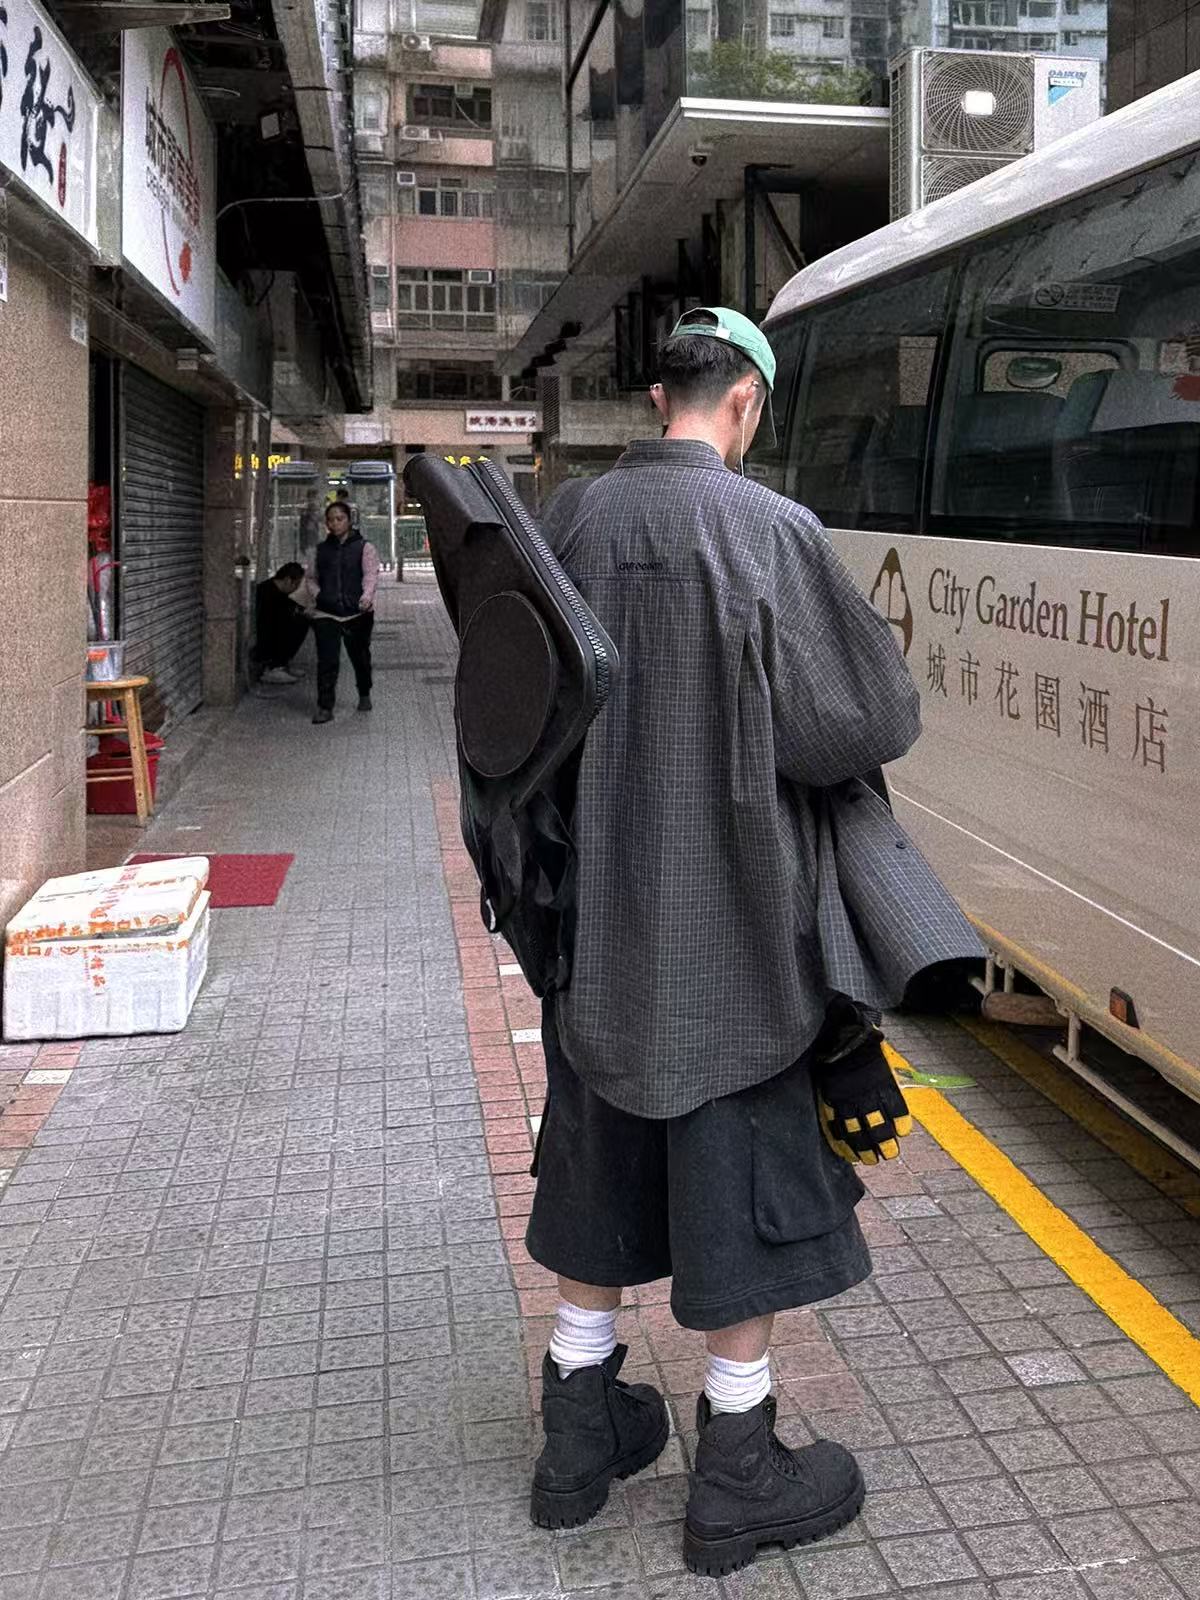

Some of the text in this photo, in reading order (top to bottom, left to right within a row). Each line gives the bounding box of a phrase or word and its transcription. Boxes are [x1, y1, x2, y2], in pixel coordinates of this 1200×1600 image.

[1049, 69, 1087, 79] DAIKIN
[928, 567, 1170, 662] City Garden Hotel
[926, 642, 1170, 774] 城市花園酒店
